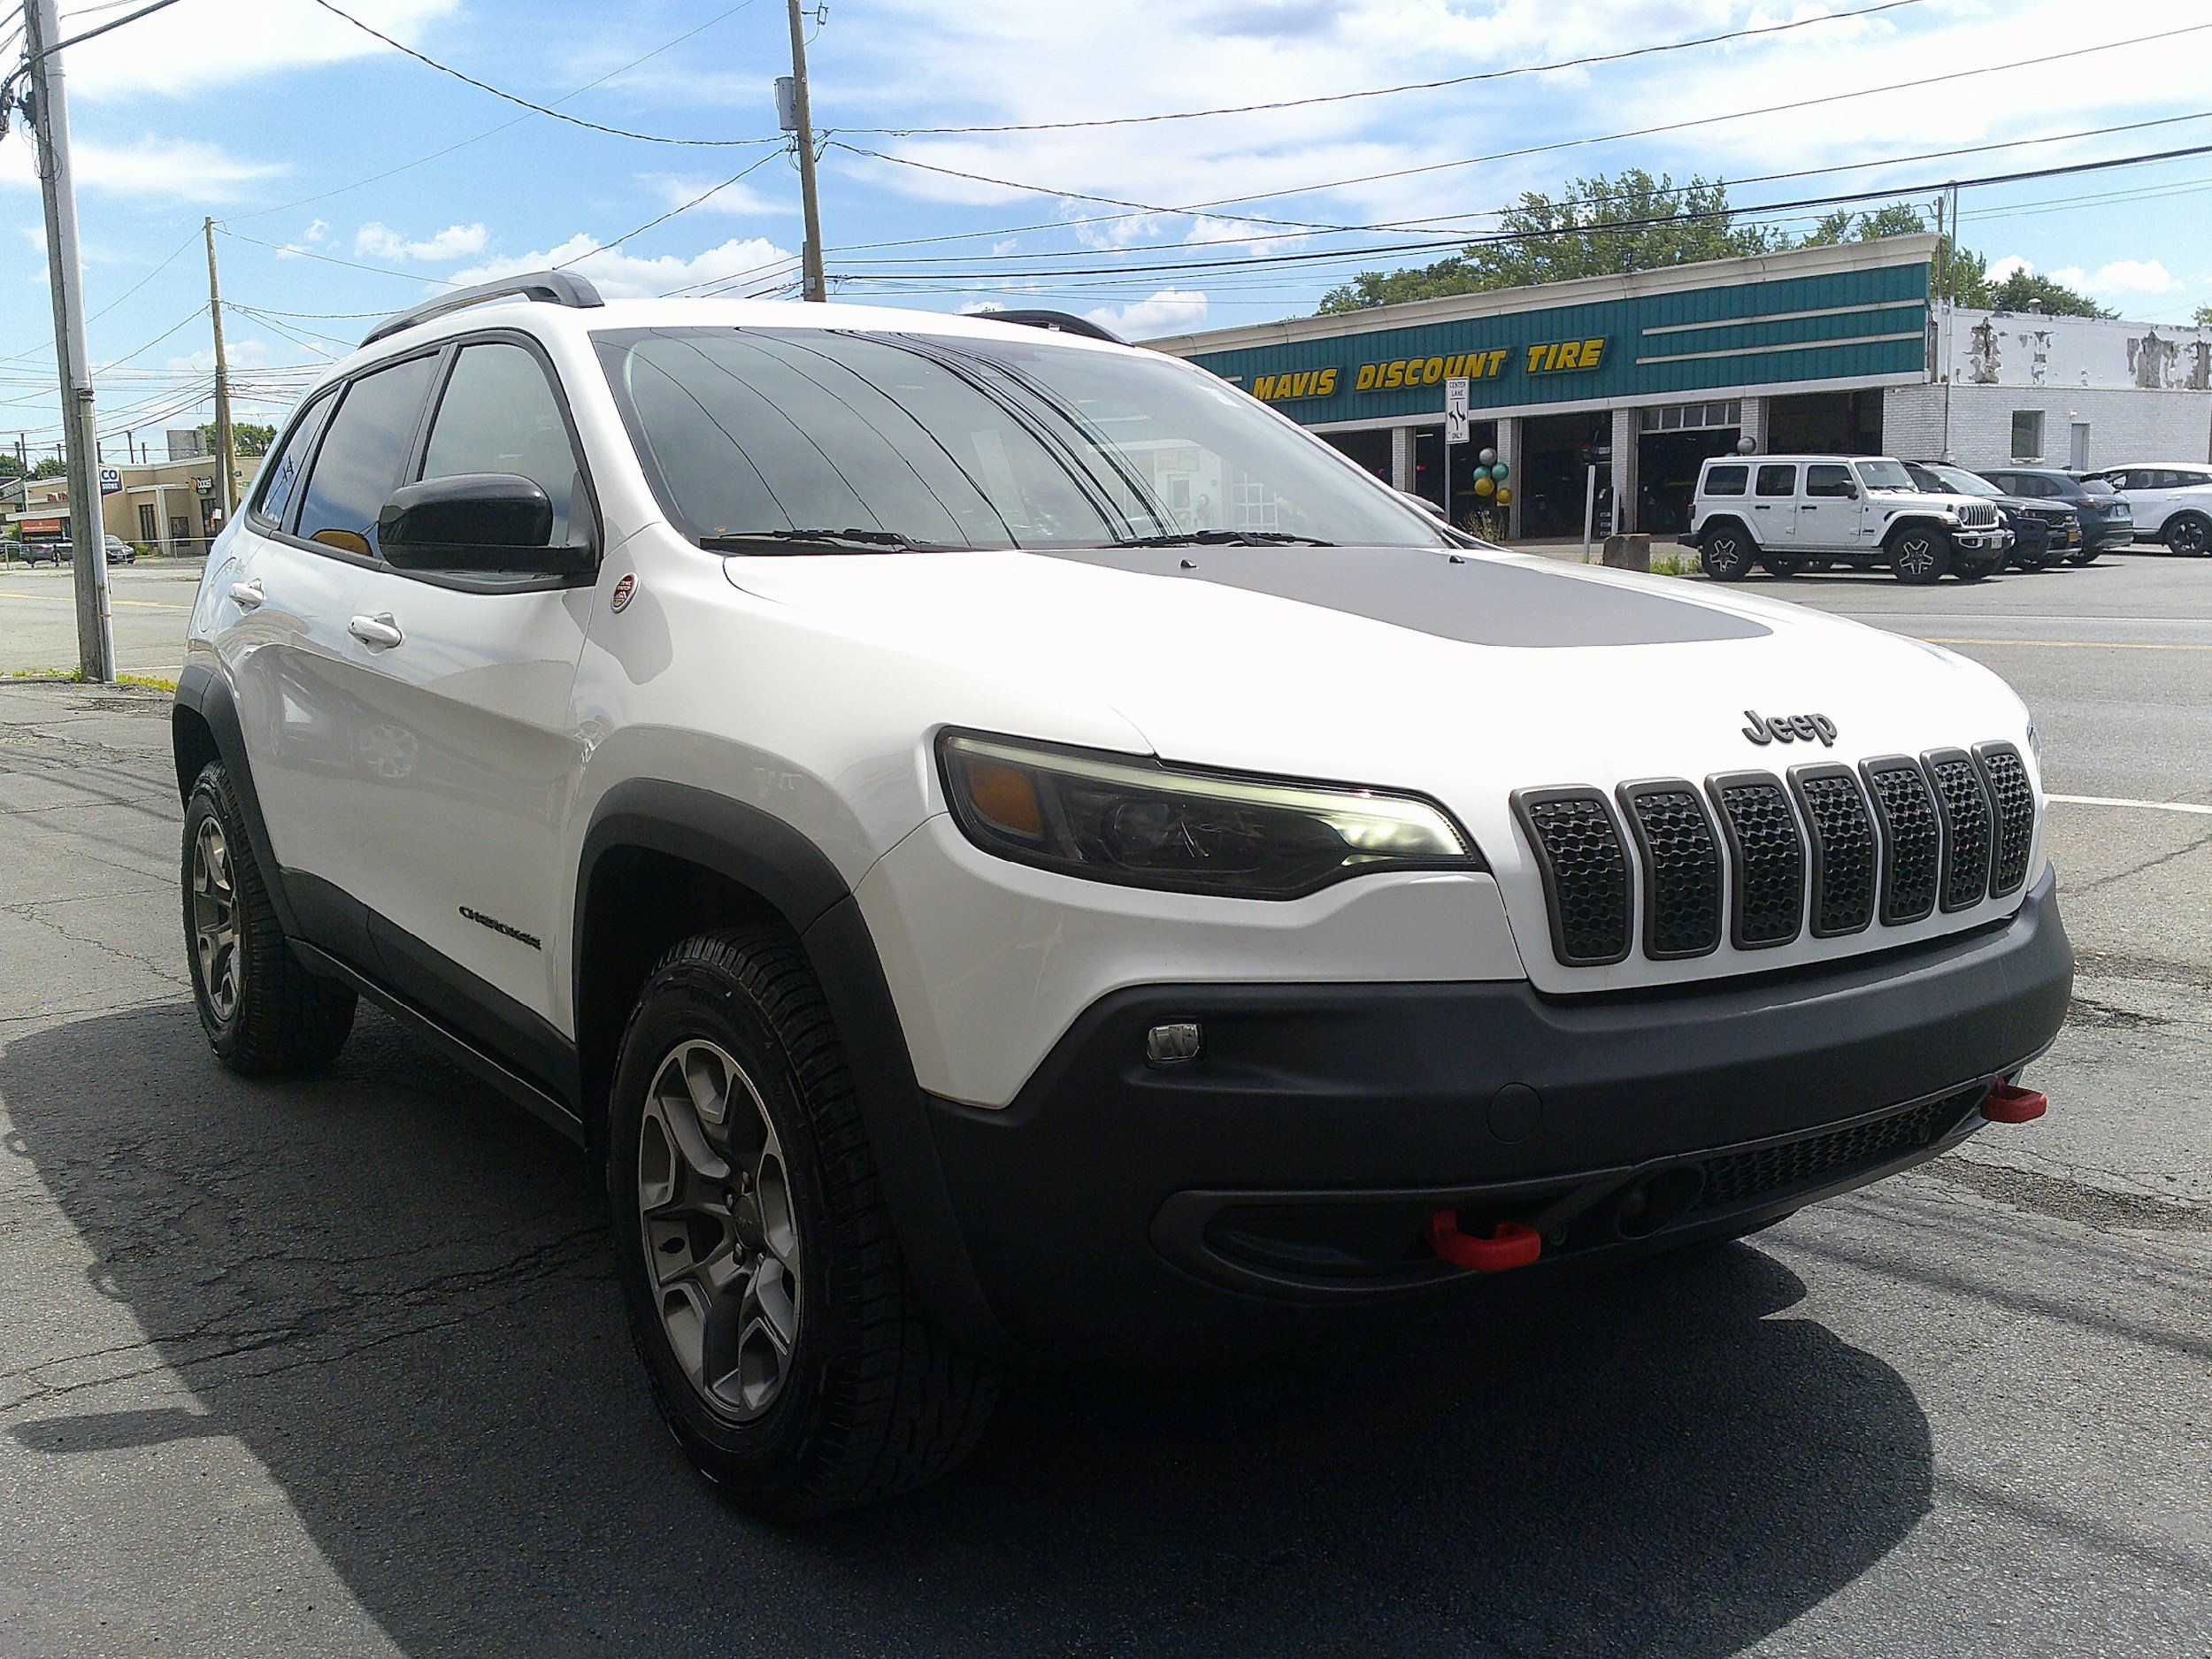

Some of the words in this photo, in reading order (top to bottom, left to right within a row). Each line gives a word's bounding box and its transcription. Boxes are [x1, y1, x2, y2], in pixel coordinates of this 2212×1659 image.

[1252, 367, 1339, 401] MAVIS
[1356, 349, 1507, 390] DISCOUNT
[1527, 338, 1606, 373] TIRE
[1742, 710, 1838, 748] Jeep
[459, 906, 541, 951] CHEROKEE
